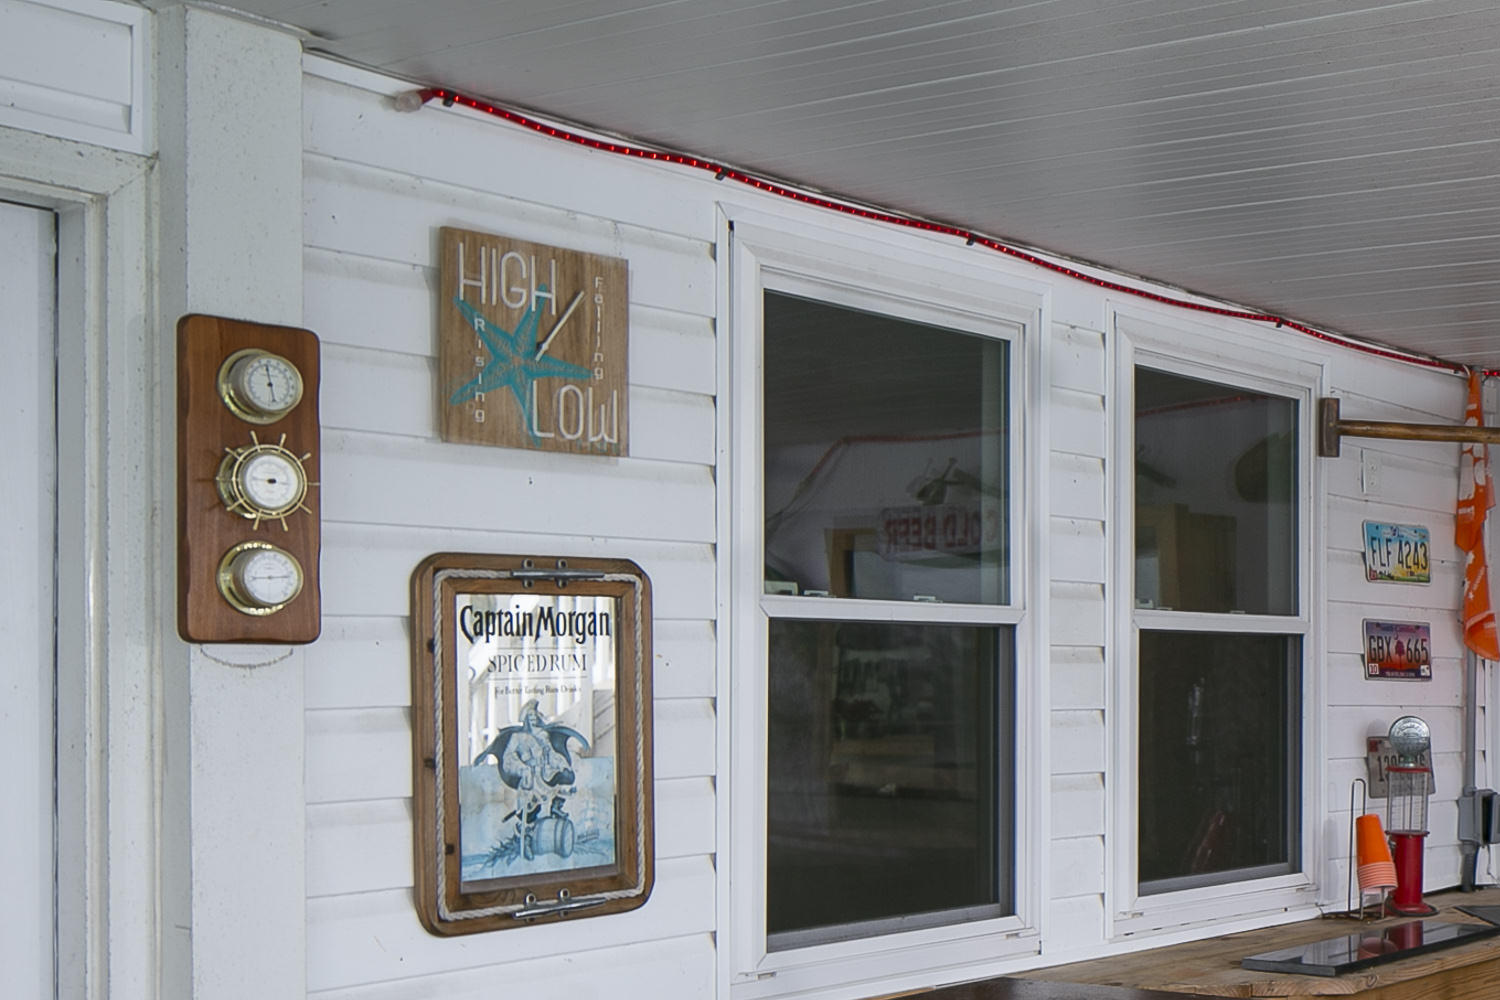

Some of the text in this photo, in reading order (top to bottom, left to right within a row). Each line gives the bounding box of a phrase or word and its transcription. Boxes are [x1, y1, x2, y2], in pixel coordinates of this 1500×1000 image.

[458, 242, 556, 315] HIGH
[474, 317, 486, 423] Rising
[532, 380, 618, 443] LOW
[1370, 536, 1428, 570] FLF 4243
[459, 604, 610, 645] Captain Morgan
[487, 653, 586, 673] SPICED RUM
[1369, 635, 1428, 664] GBX 665
